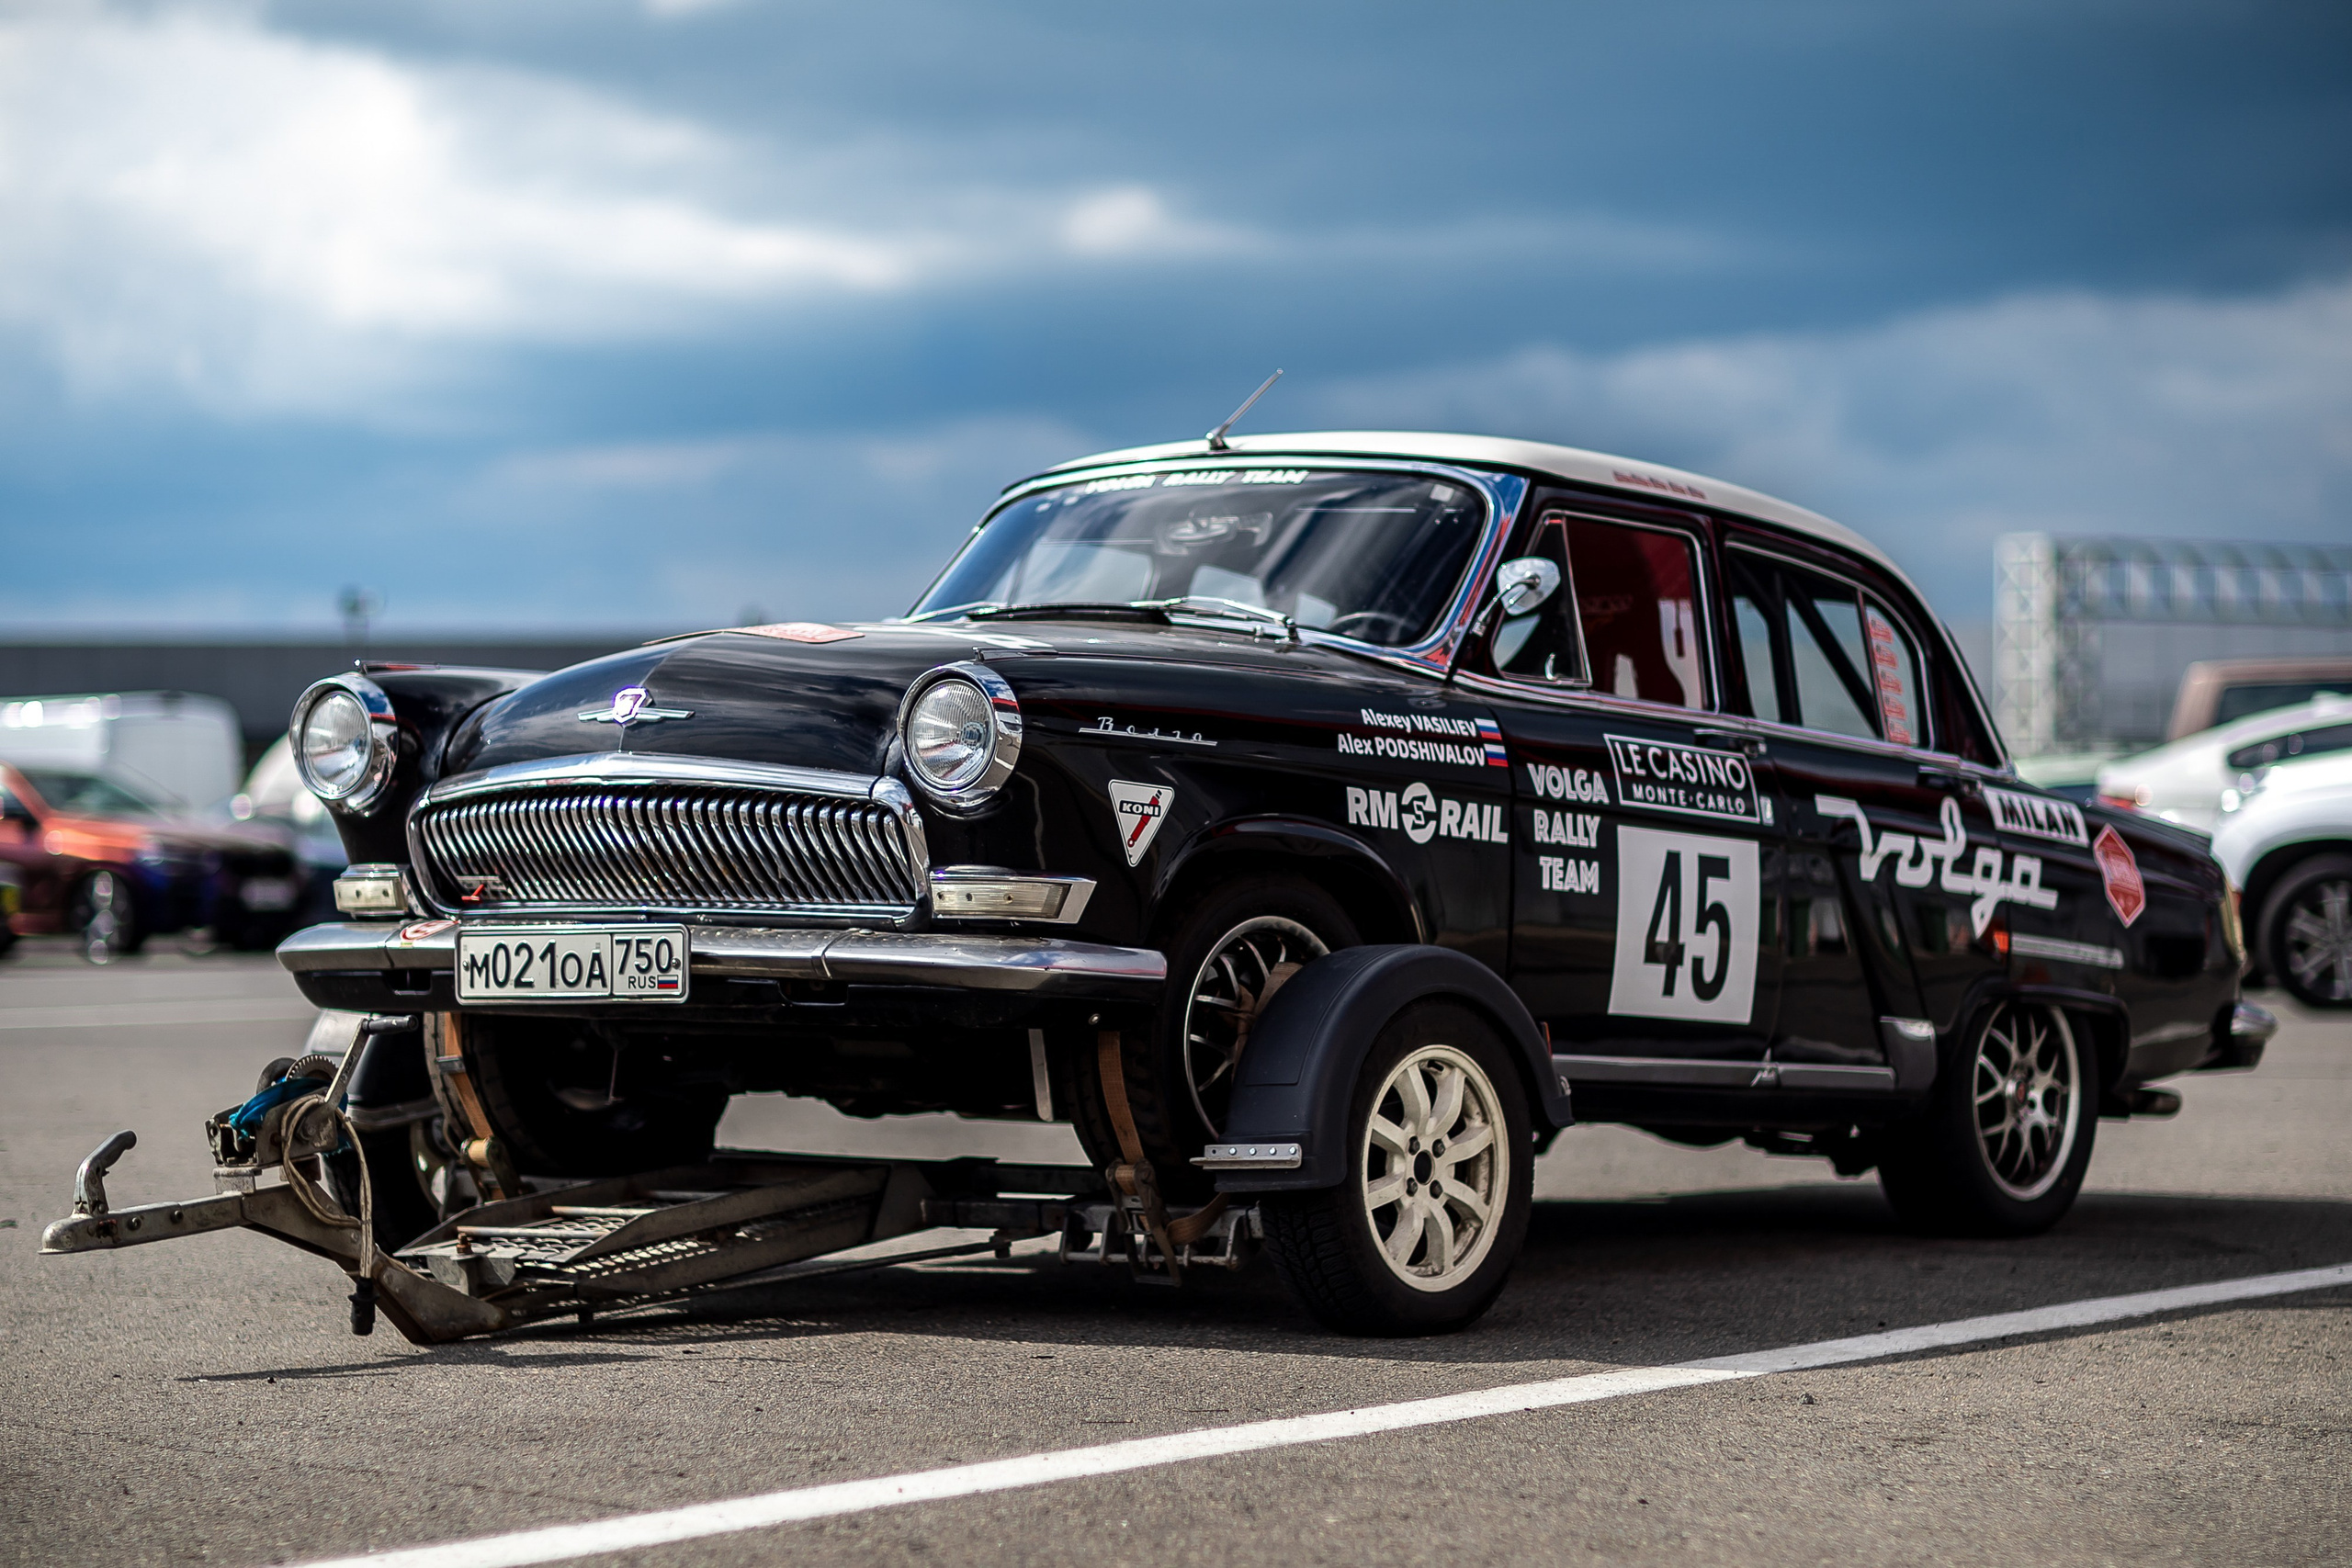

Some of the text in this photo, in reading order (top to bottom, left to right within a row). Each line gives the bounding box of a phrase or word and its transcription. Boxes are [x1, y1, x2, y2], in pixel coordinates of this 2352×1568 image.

[1241, 469, 1310, 485] TEAM
[1361, 708, 1477, 738] Alexey VASILIEV
[1338, 733, 1486, 767] Alex PODSHIVALOV
[1614, 741, 1747, 791] LE CASINO
[1526, 762, 1610, 805] VOLGA
[1122, 803, 1159, 816] KONI
[1346, 786, 1509, 844] RM RAIL
[1533, 808, 1600, 849] RALLY
[1996, 793, 2080, 838] MILAN
[1539, 855, 1600, 895] TEAM
[1643, 849, 1732, 1001] 45
[615, 936, 673, 976] 750
[628, 976, 656, 989] RUS
